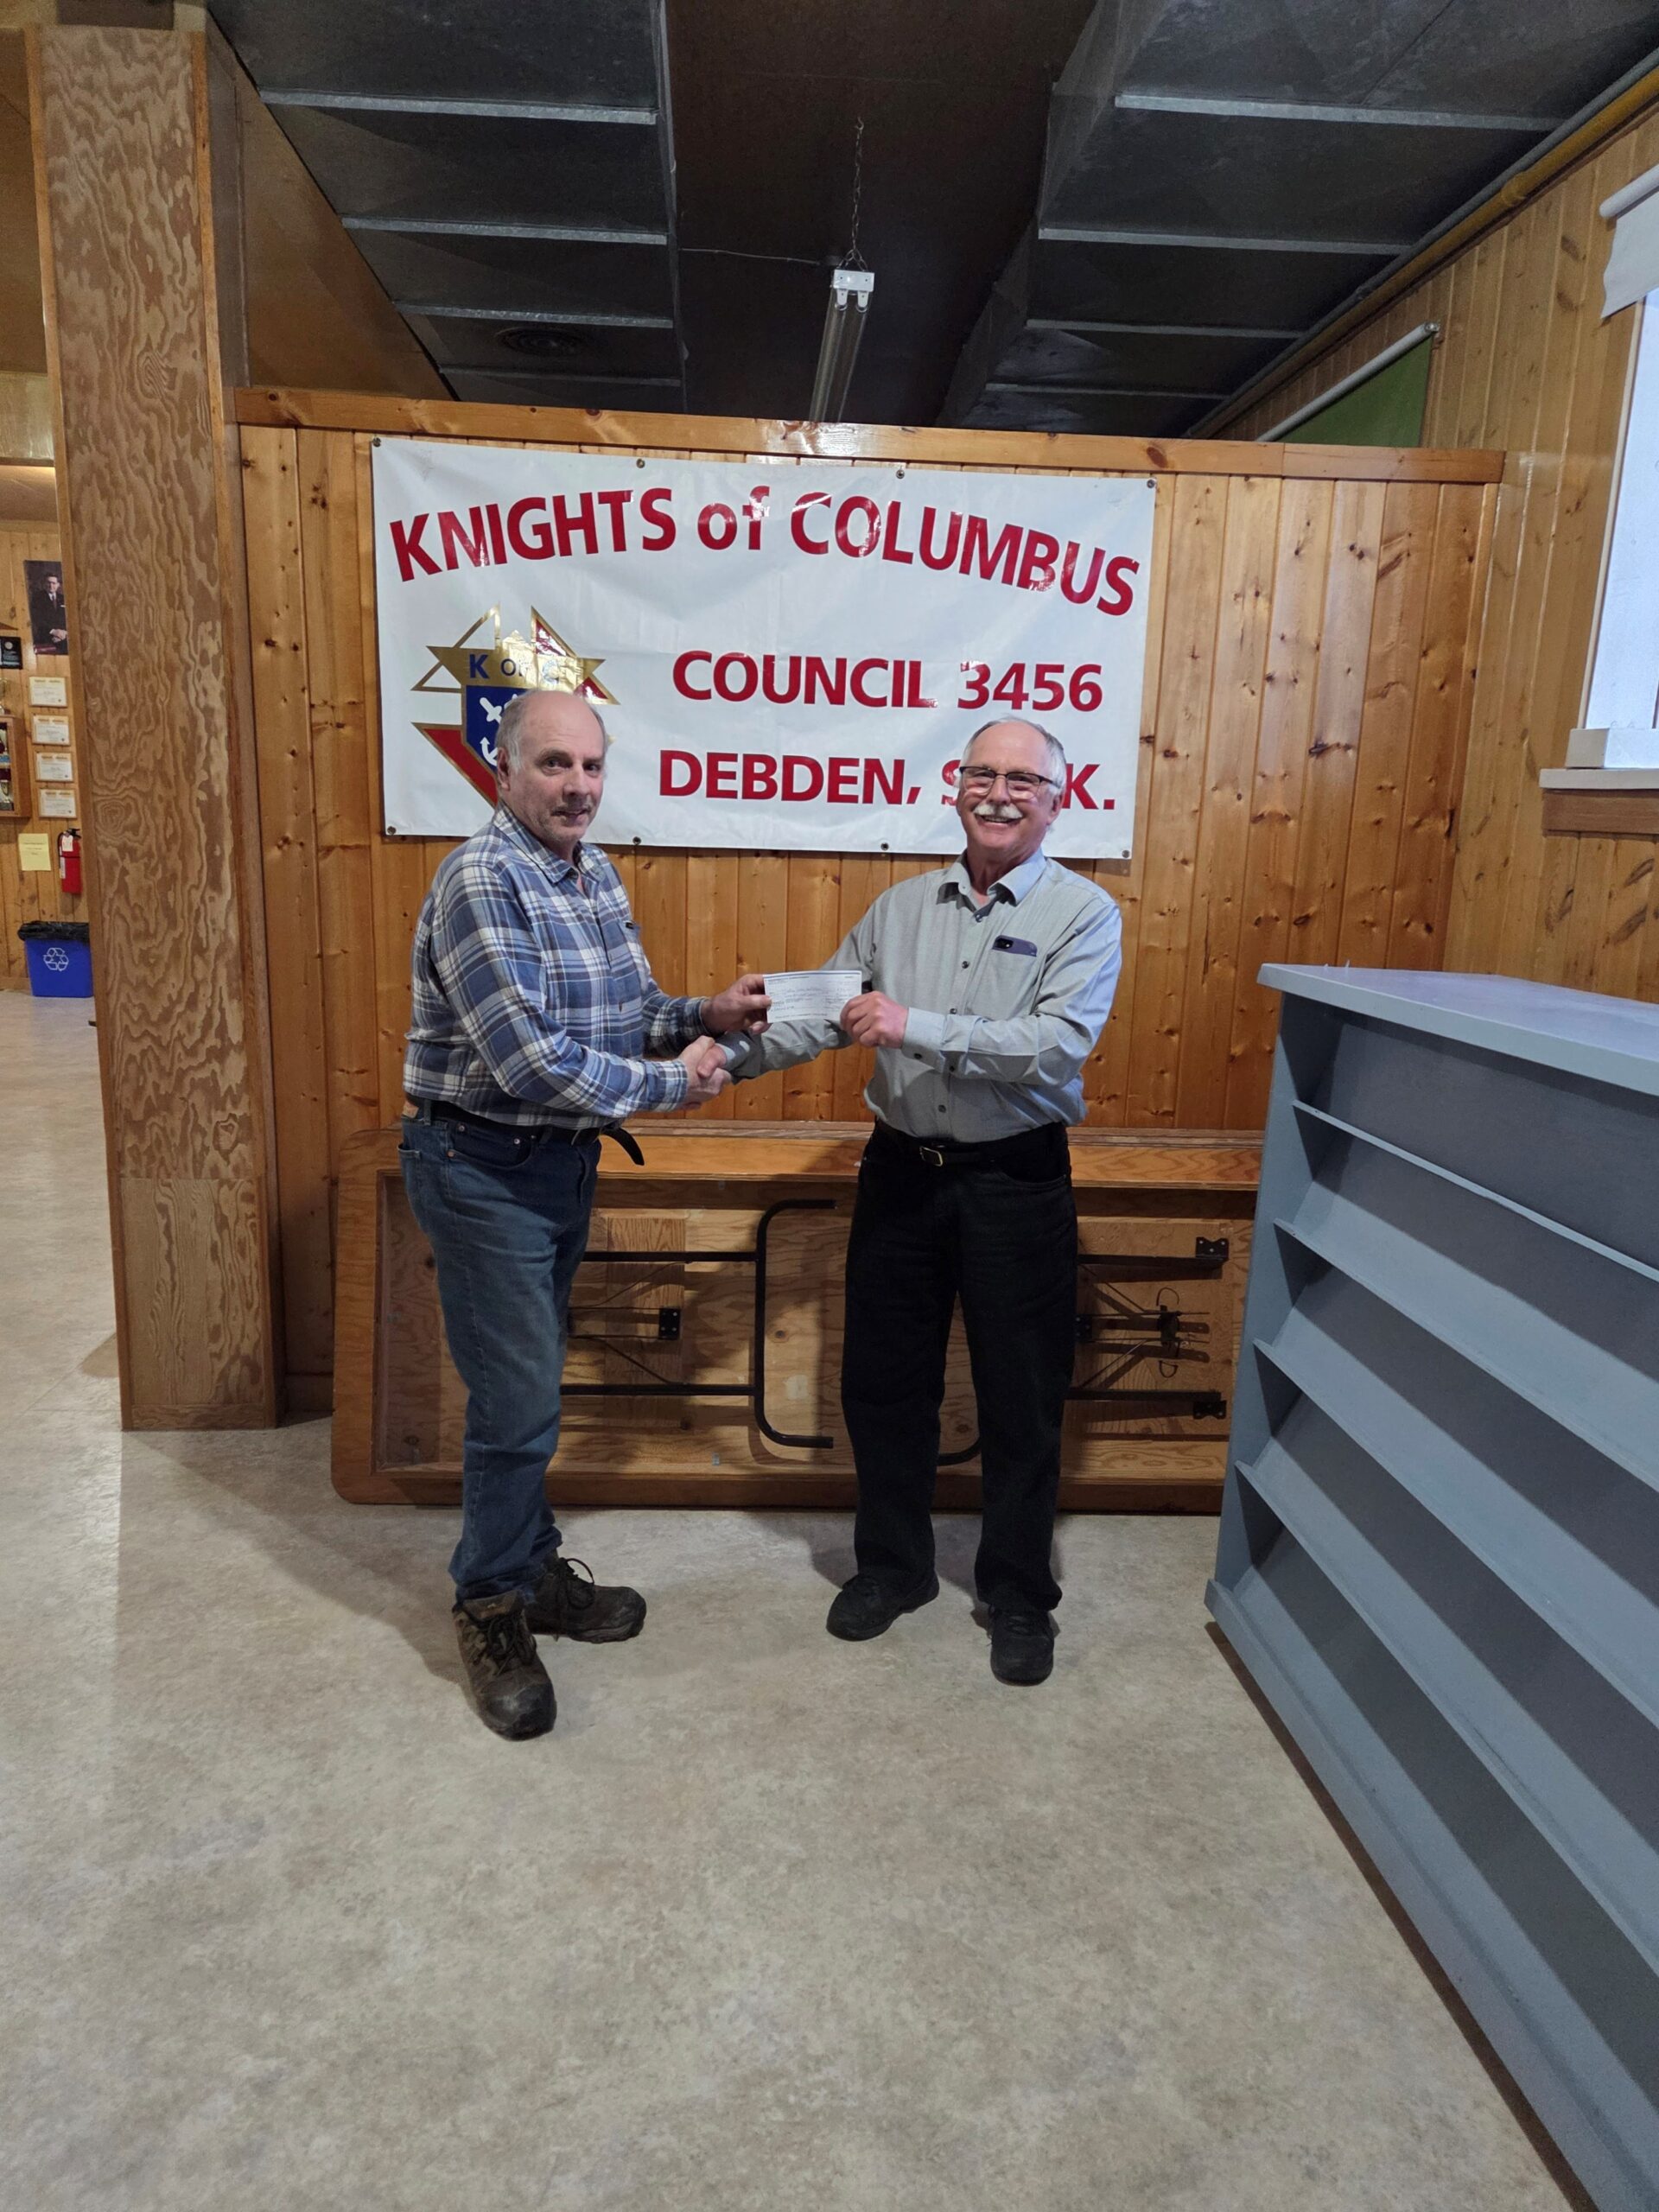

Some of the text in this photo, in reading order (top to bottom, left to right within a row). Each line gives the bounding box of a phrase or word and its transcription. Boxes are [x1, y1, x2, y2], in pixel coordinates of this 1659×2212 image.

[390, 486, 1140, 616] KNIGHTS of COLUMBUS
[469, 653, 489, 679] K
[673, 651, 1103, 712] COUNCIL 3456
[660, 750, 1115, 810] DEBDEN, SK.
